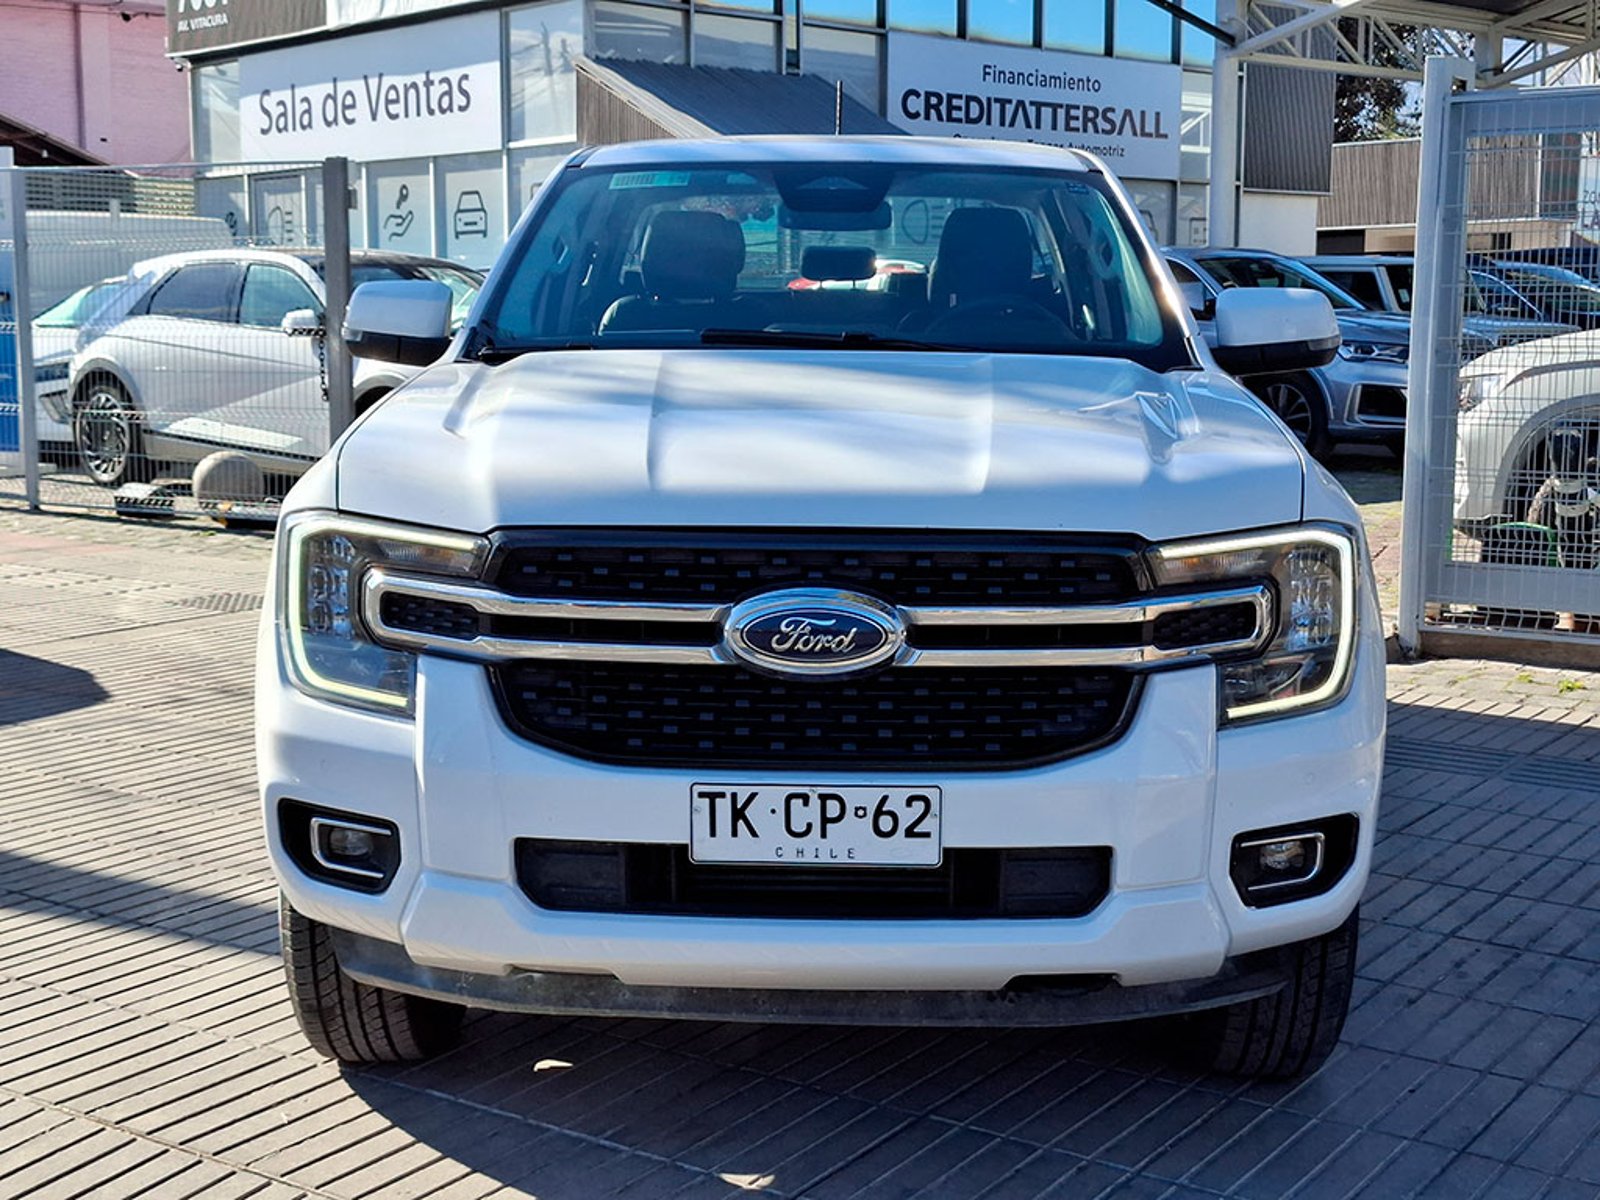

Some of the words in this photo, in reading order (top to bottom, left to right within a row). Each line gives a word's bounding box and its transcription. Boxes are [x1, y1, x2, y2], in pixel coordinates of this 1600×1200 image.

[982, 64, 1102, 92] Financiamiento
[259, 83, 313, 136] Sala
[321, 76, 356, 128] de
[363, 71, 472, 123] Ventas
[901, 88, 1169, 139] CREDITATTERSALL
[771, 616, 860, 653] Ford
[775, 847, 856, 859] CHILE
